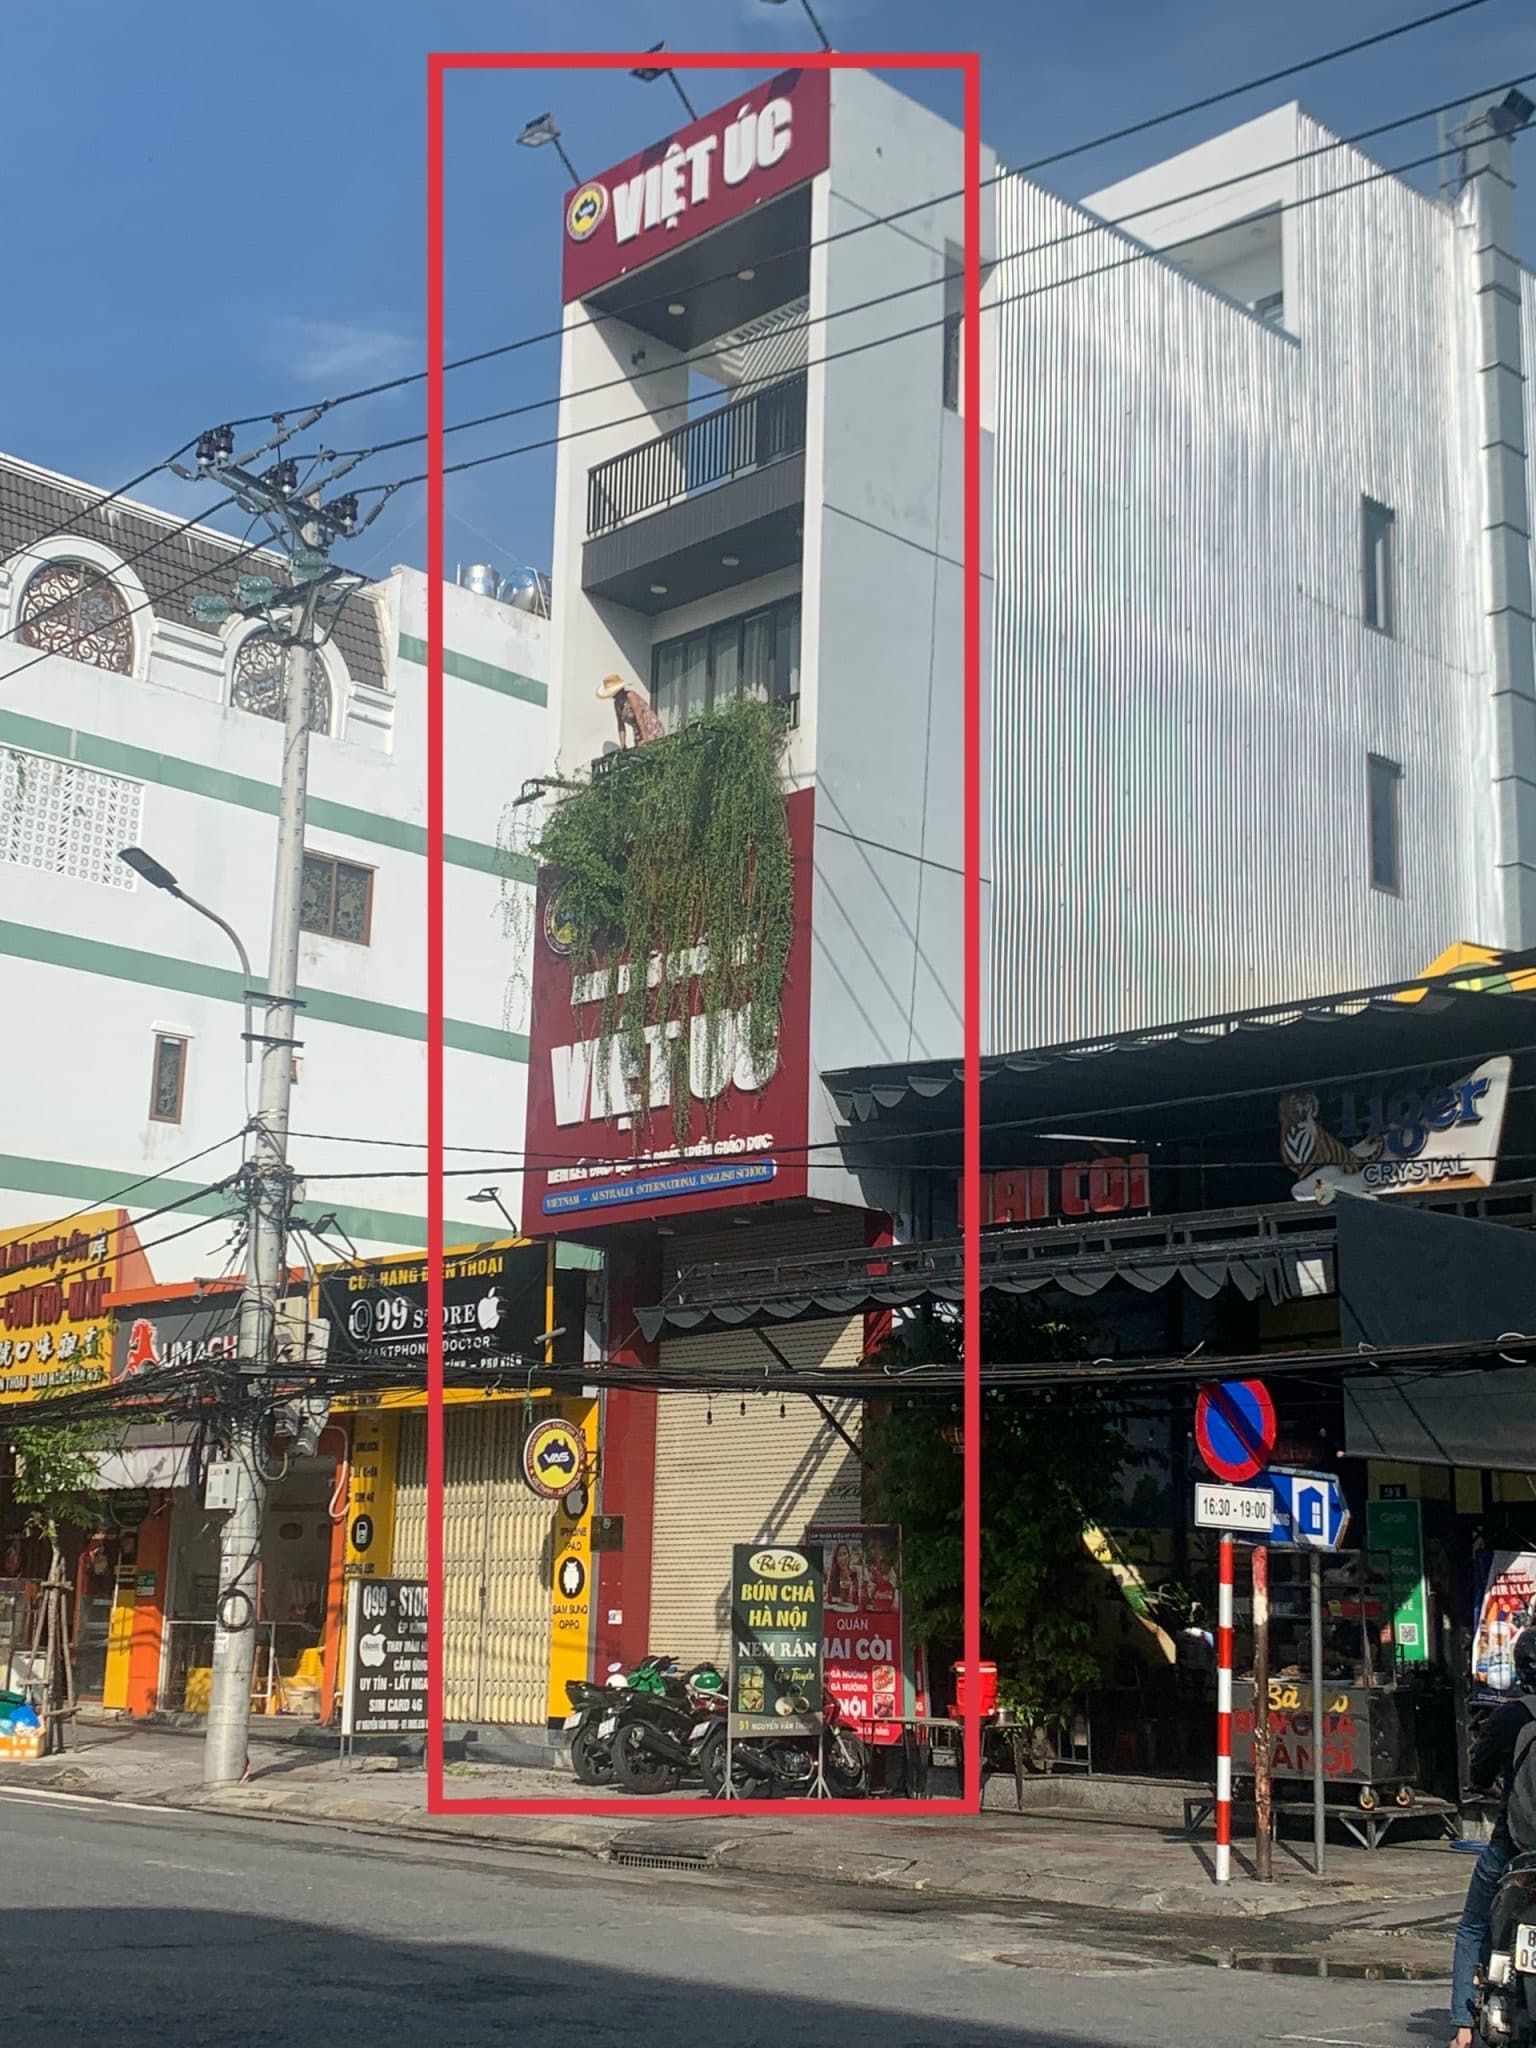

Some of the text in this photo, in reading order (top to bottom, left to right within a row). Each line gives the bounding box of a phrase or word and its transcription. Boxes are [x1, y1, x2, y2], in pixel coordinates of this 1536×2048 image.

[612, 134, 717, 245] VIỆT
[723, 97, 793, 187] ÚC
[1336, 1077, 1490, 1159] Tiger
[1363, 1155, 1471, 1187] CRYSTAL
[591, 1188, 634, 1202] AUSTRALIA
[636, 1176, 698, 1195] INTERNATIONAL
[700, 1169, 735, 1185] ENGLISH
[460, 1256, 503, 1279] THOẠI
[543, 1451, 570, 1463] VAS
[1203, 1497, 1231, 1517] 16:30
[1239, 1501, 1267, 1520] 19:00
[560, 1526, 587, 1539] IPHONE
[362, 1585, 388, 1620] Q99
[742, 1579, 815, 1603] BÚN CHẢ
[558, 1618, 580, 1630] OPPO
[749, 1606, 808, 1630] HÀ NỘI
[738, 1638, 817, 1658] NEM RÁN
[855, 1633, 893, 1661] CÒI
[359, 1677, 371, 1692] UY
[373, 1674, 388, 1691] TÍN
[368, 1698, 423, 1713] SIM CARD 4G
[738, 1720, 749, 1731] 91
